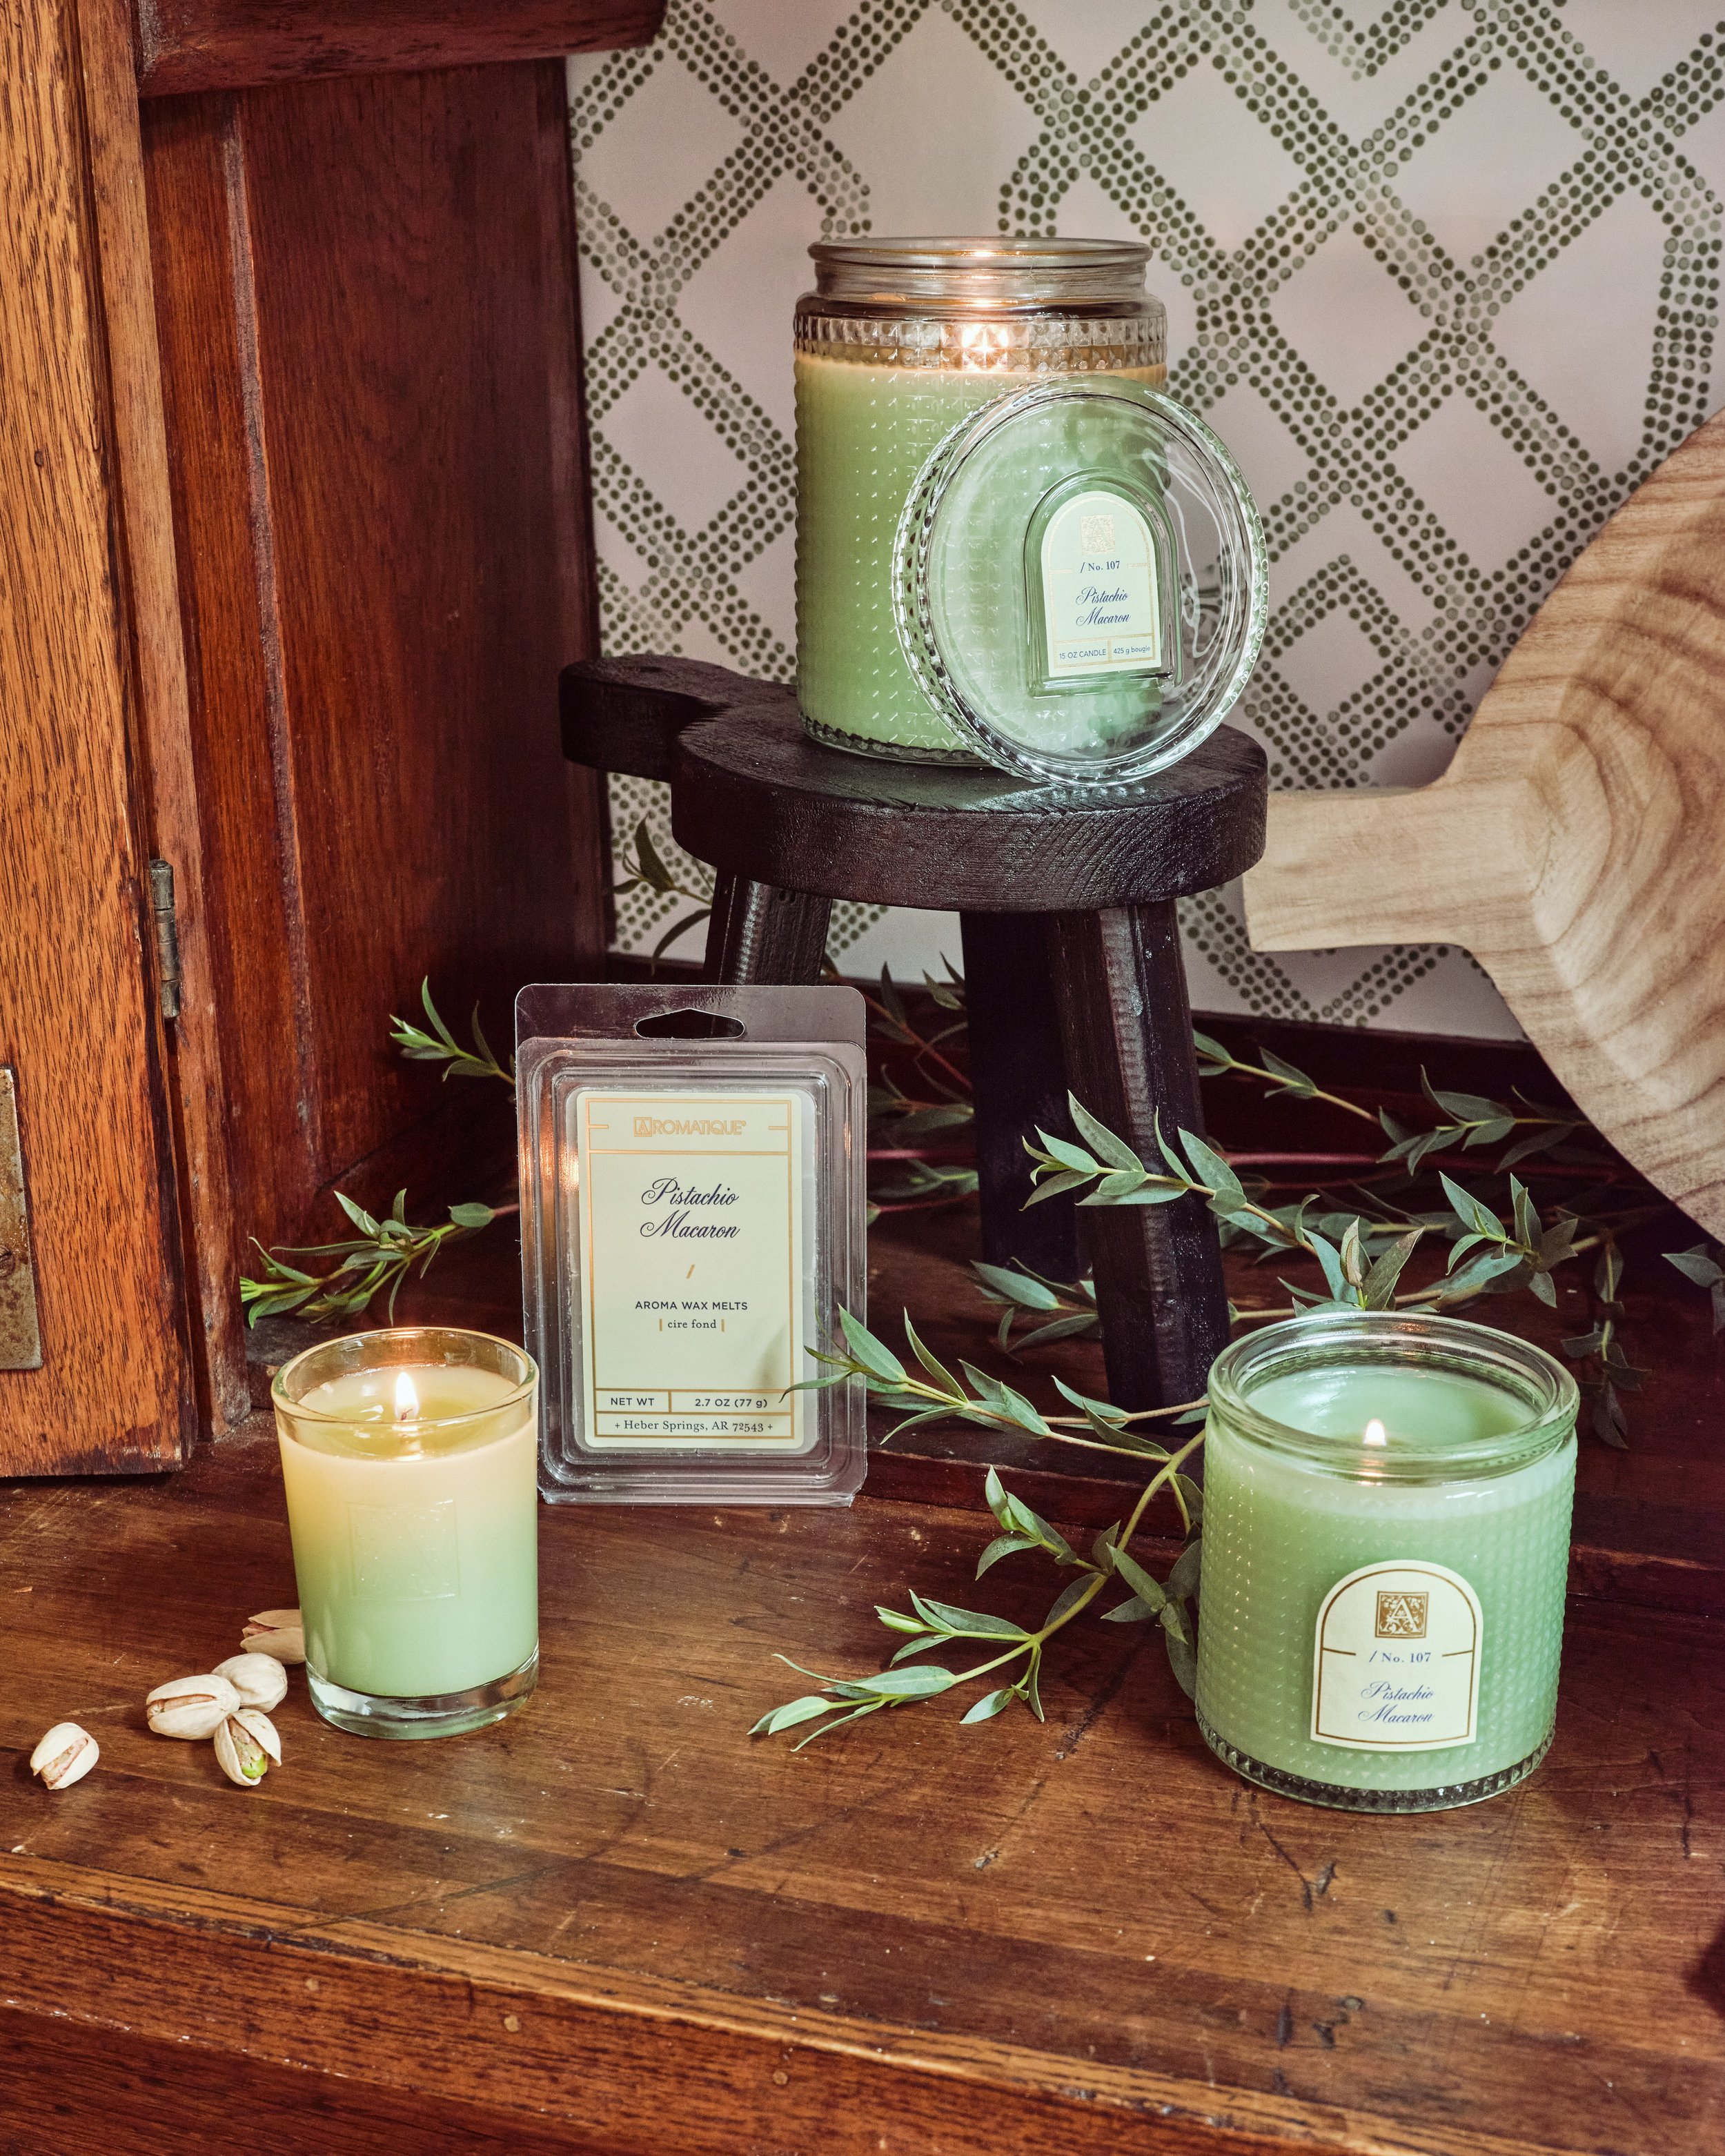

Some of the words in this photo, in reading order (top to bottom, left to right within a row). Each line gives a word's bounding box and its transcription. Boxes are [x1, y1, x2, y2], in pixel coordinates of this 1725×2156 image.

[1088, 563, 1103, 571] No.
[1106, 561, 1121, 570] 107
[1076, 586, 1130, 605] Pistachio
[1076, 606, 1132, 626] Macaron
[1079, 649, 1106, 657] CANDLE
[1131, 645, 1151, 653] bougie
[641, 1177, 740, 1205] Pistachio
[640, 1209, 740, 1238] Macaron
[635, 1301, 678, 1310] AROMA
[682, 1301, 708, 1310] WAX
[712, 1302, 748, 1311] MELTS
[668, 1319, 688, 1329] cire
[691, 1319, 717, 1329] fond
[611, 1397, 632, 1406] NET
[637, 1398, 655, 1406] WT
[695, 1398, 711, 1407] 2.7
[715, 1398, 731, 1407] OZ
[734, 1398, 751, 1407] (77
[756, 1398, 767, 1408] g)
[624, 1420, 659, 1430] Heber
[662, 1421, 708, 1433] Springs,
[711, 1421, 729, 1430] AR
[732, 1423, 764, 1433] 72543
[1382, 1653, 1404, 1663] No.
[1410, 1652, 1431, 1663] 107
[1361, 1681, 1435, 1700] Pistachio
[1358, 1703, 1435, 1723] Macaron
